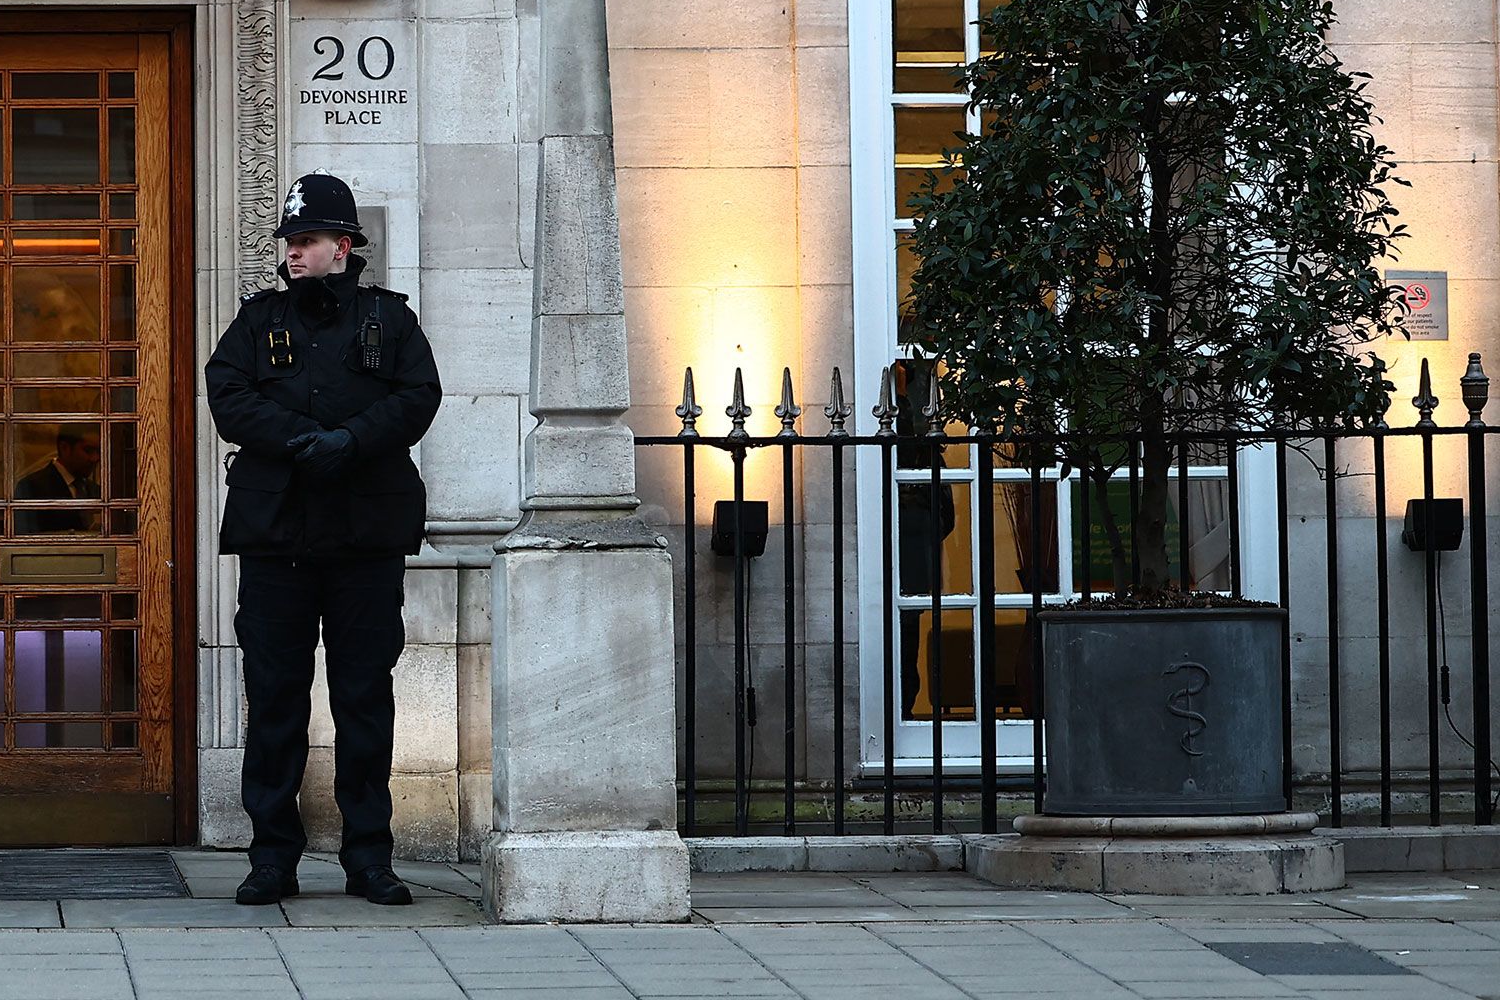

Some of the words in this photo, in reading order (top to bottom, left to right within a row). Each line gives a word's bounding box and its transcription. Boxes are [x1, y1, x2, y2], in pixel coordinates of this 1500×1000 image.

[312, 35, 395, 81] 20
[300, 90, 408, 104] DEVONSHIRE
[325, 110, 382, 125] PLACE
